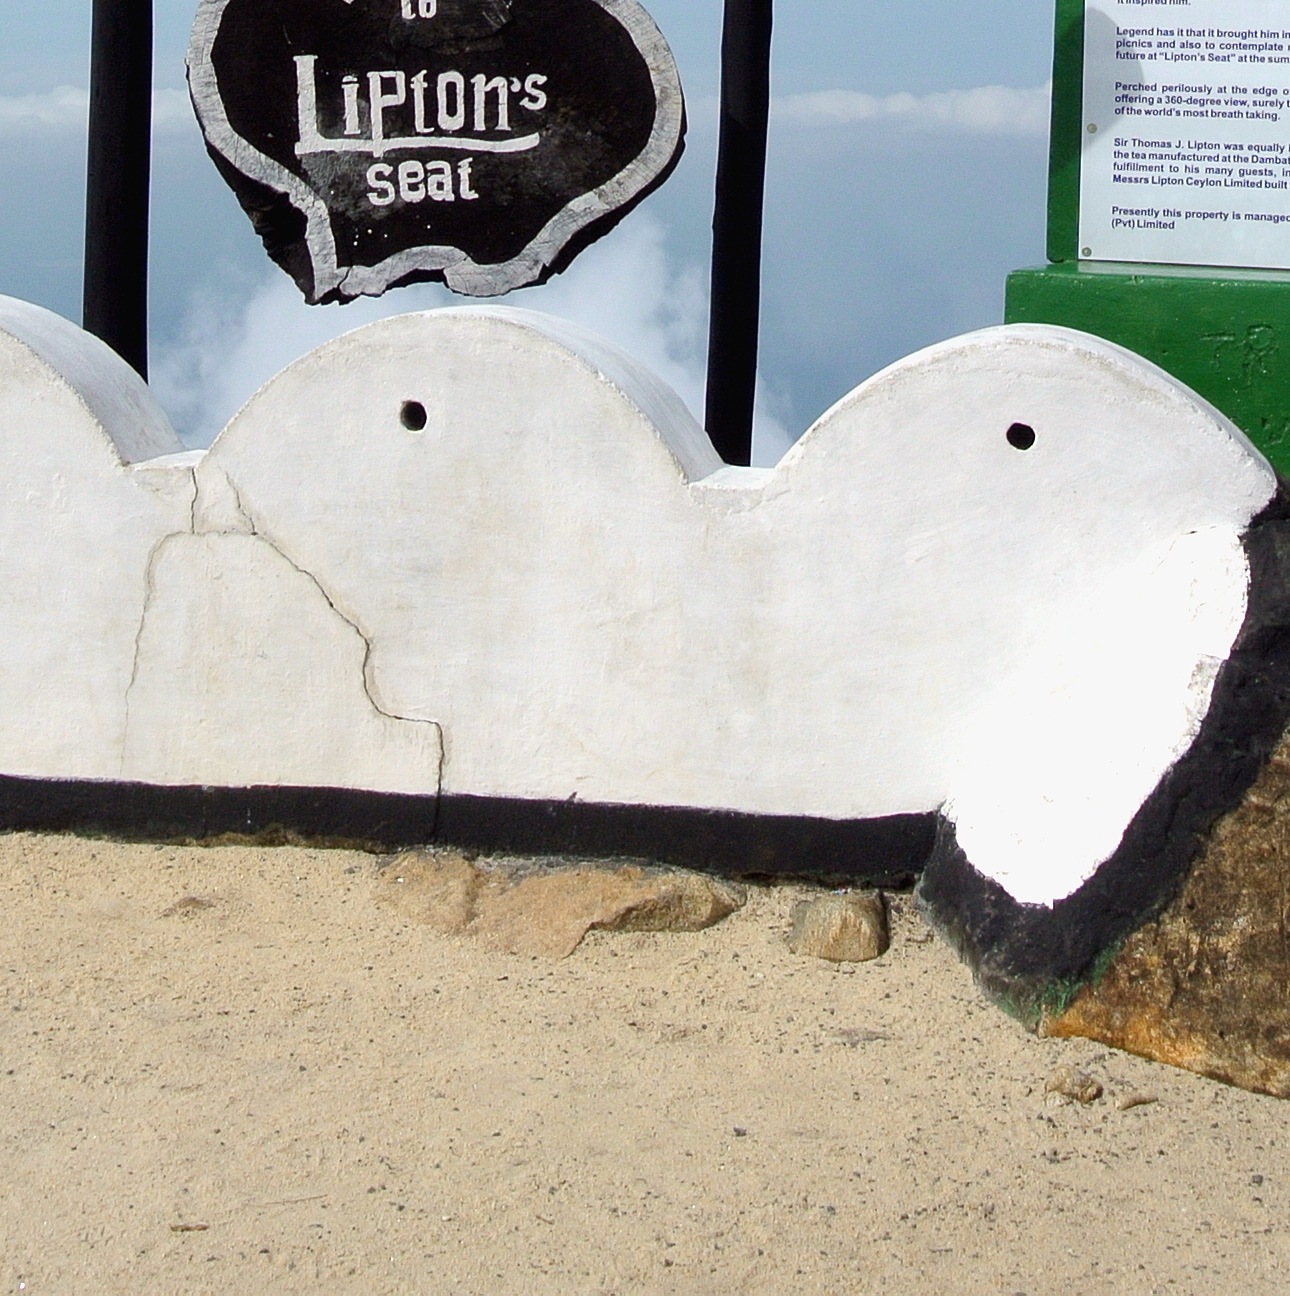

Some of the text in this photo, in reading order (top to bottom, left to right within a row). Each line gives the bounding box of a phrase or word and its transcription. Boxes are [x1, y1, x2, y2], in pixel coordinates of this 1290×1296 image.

[1116, 26, 1154, 38] Legend
[1156, 27, 1174, 36] has
[1176, 27, 1183, 37] it
[1185, 28, 1205, 37] that
[1207, 28, 1215, 37] it
[1216, 28, 1258, 40] brought
[1259, 29, 1279, 39] him
[1115, 38, 1152, 50] picnics
[1156, 38, 1175, 48] and
[1179, 39, 1201, 49] also
[1204, 41, 1215, 50] to
[1219, 41, 1283, 53] contemplate
[1115, 50, 1145, 60] future
[1147, 51, 1157, 60] at
[1237, 53, 1247, 62] at
[1249, 53, 1265, 63] the
[1115, 81, 1157, 92] Perched
[1161, 83, 1212, 95] perilously
[1217, 85, 1226, 94] at
[1231, 85, 1247, 94] the
[1252, 85, 1277, 97] edge
[1114, 137, 1128, 147] Sir
[1131, 138, 1171, 148] Thomas
[1175, 139, 1184, 148] J.
[1187, 140, 1220, 152] Lipton
[1247, 142, 1285, 154] equally
[1113, 149, 1129, 159] the
[1131, 151, 1146, 159] tea
[1148, 150, 1219, 162] manufactured
[1221, 154, 1231, 162] at
[1232, 154, 1249, 163] the
[1113, 161, 1164, 172] fulfillment
[1169, 164, 1179, 173] to
[1184, 164, 1199, 173] his
[1204, 167, 1233, 177] many
[1238, 167, 1276, 178] guests,
[366, 158, 479, 206] seat
[1112, 174, 1149, 184] Messrs
[1151, 175, 1184, 187] Lipton
[1185, 176, 1222, 189] Ceylon
[1223, 178, 1262, 188] Limited
[1264, 179, 1287, 189] built
[1111, 206, 1160, 218] Presently
[1162, 208, 1181, 217] this
[1184, 210, 1229, 221] property
[1232, 210, 1241, 220] is
[1111, 217, 1175, 230] (Pvt) Limited
